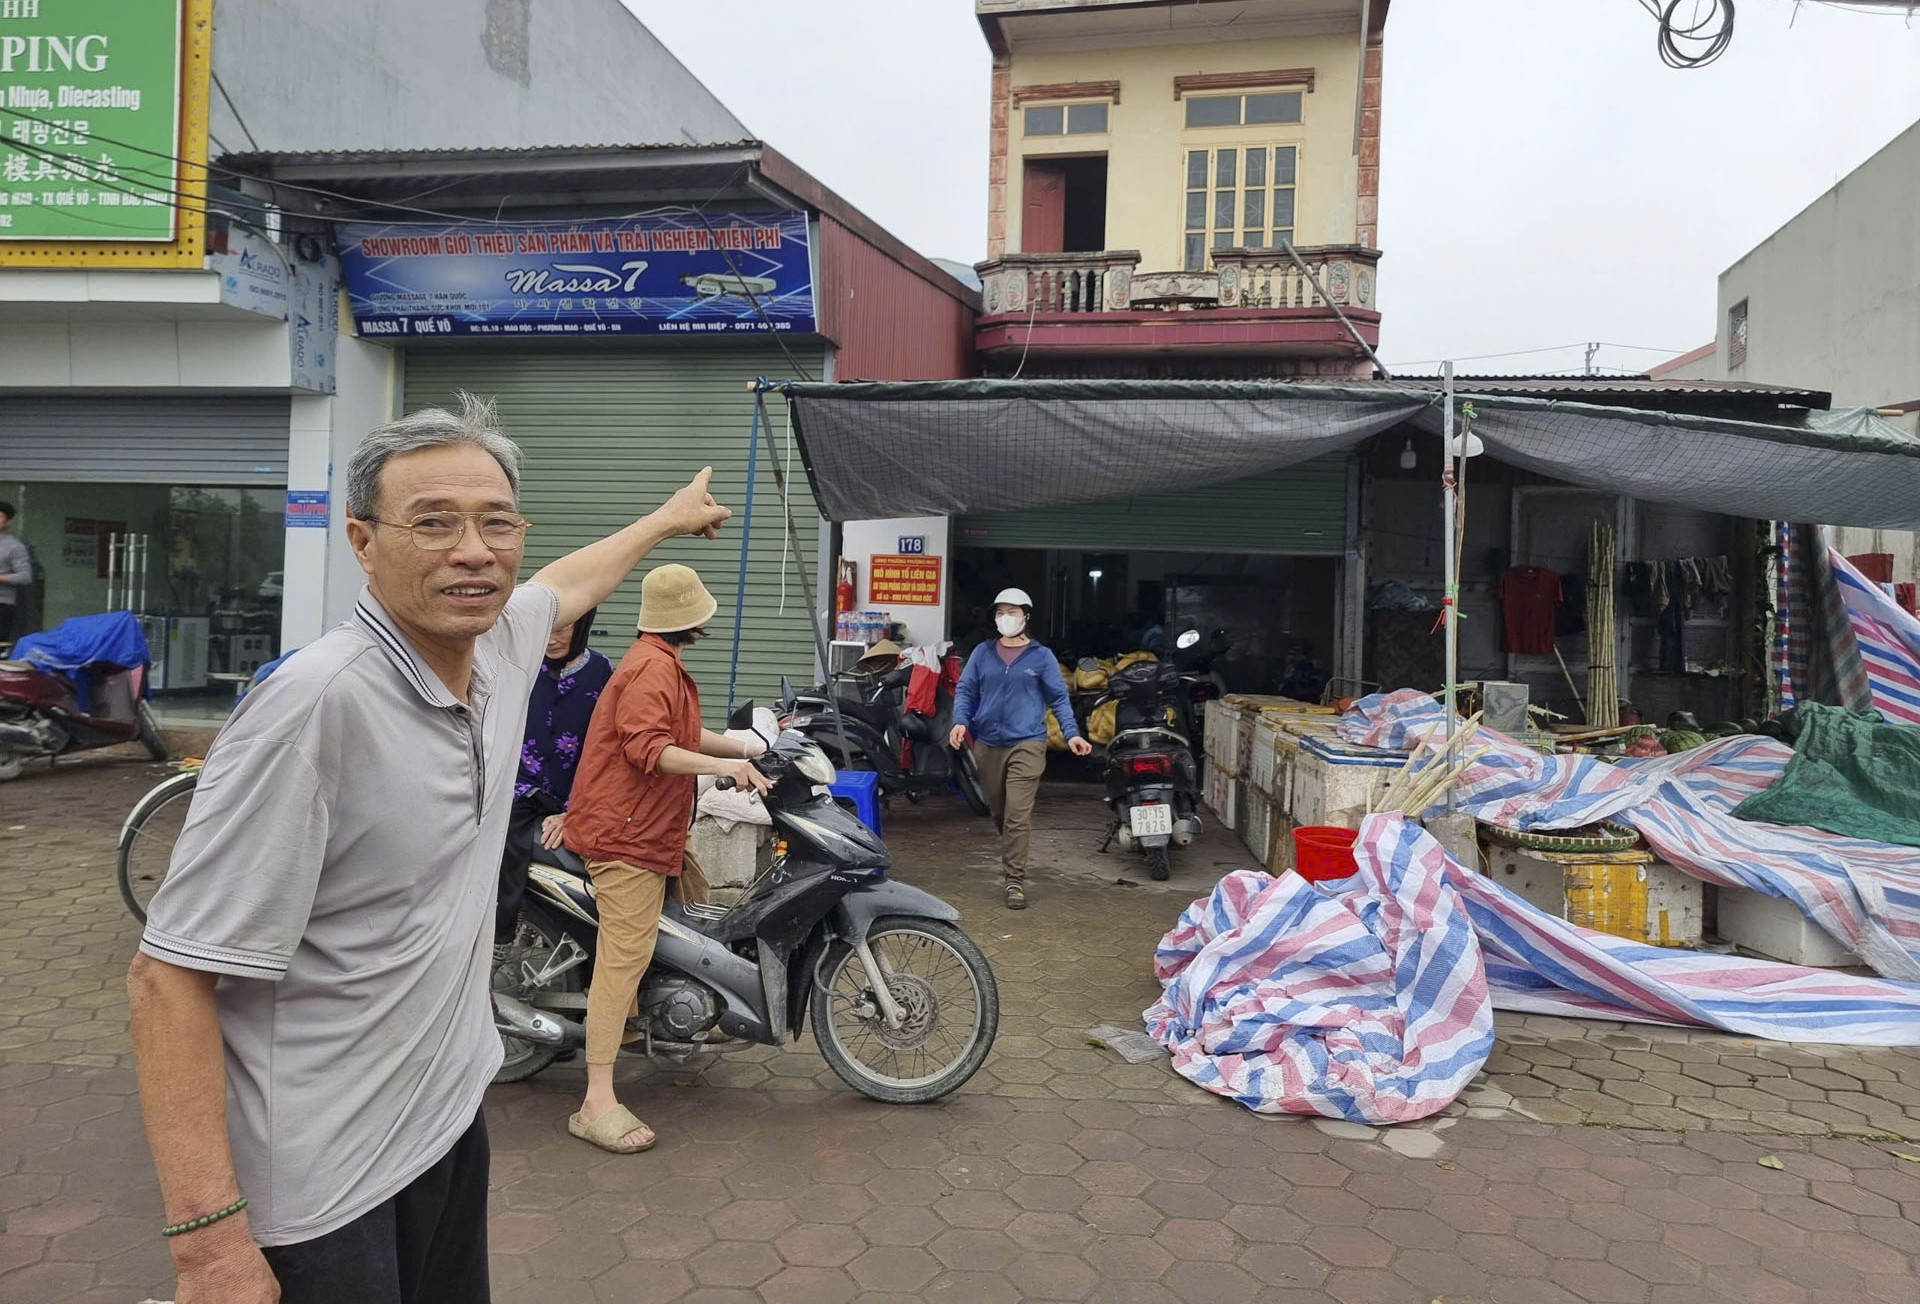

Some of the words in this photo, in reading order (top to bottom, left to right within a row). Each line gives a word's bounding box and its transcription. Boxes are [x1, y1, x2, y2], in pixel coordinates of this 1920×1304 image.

[0, 34, 109, 72] PING
[58, 85, 140, 111] Diecasting
[361, 236, 441, 258] SHOWROOM
[444, 231, 472, 256] GIỚI
[474, 232, 514, 259] THIỆU
[517, 227, 548, 254] SẢN
[551, 223, 592, 254] PHẨM
[593, 227, 615, 252] VÀ
[617, 223, 650, 251] TRẢI
[652, 225, 710, 255] NGHIỆM
[754, 223, 781, 249] PHÍ
[362, 320, 400, 334] MASSA
[400, 317, 408, 333] 7
[415, 316, 435, 333] QUẾ
[436, 318, 451, 333] VÕ
[659, 322, 678, 331] LIÊN
[900, 539, 922, 552] 178
[1138, 820, 1166, 834] 7826
